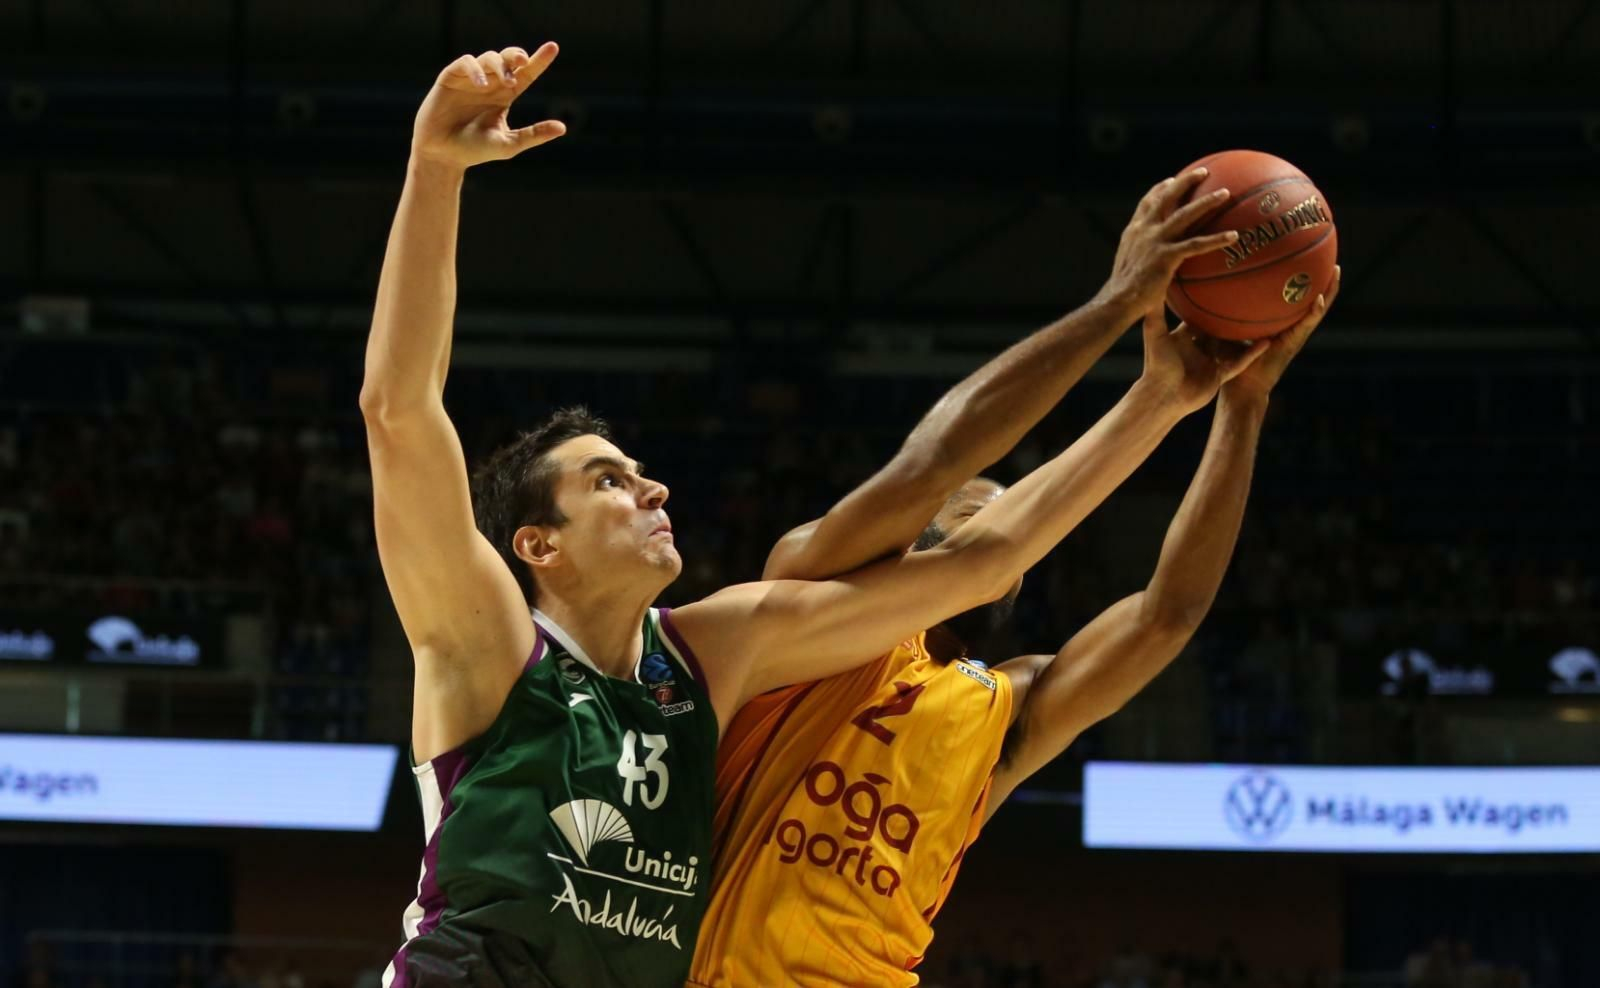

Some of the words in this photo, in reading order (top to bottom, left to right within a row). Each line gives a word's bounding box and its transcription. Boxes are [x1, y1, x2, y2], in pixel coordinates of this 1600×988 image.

[1223, 195, 1329, 269] SPALDING
[851, 680, 926, 746] 2
[617, 729, 669, 810] 43
[1444, 799, 1569, 836] Wagen
[550, 872, 681, 950] Andalucía
